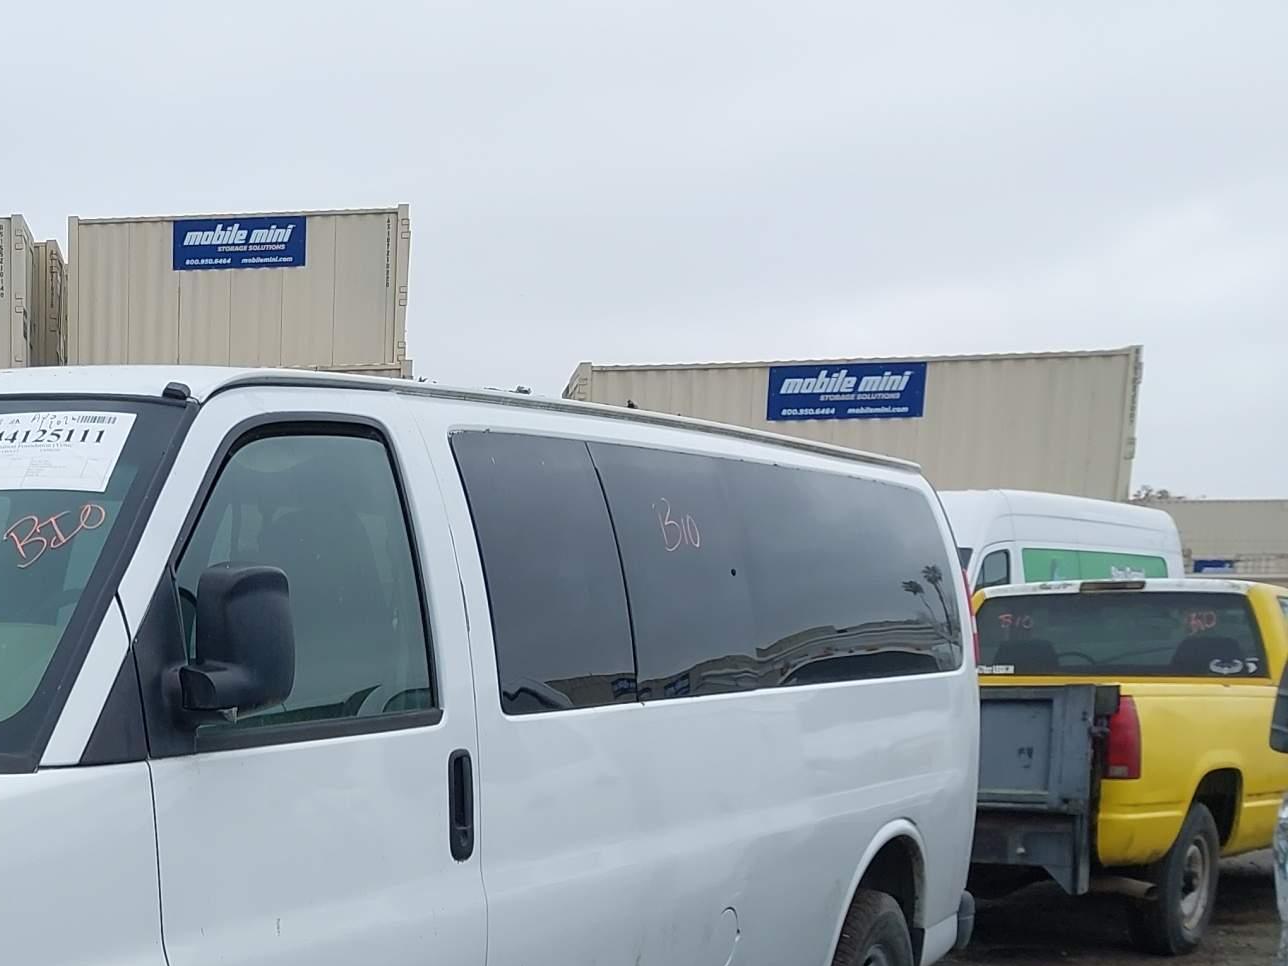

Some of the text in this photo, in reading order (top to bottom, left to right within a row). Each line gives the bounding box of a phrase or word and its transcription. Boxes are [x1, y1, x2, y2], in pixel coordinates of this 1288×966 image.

[184, 224, 294, 246] mobile mini
[241, 256, 293, 264] mobilemini.com
[779, 369, 911, 394] mobile mini
[856, 392, 901, 400] SOLUTIONS
[847, 406, 909, 414] mobilemini.com
